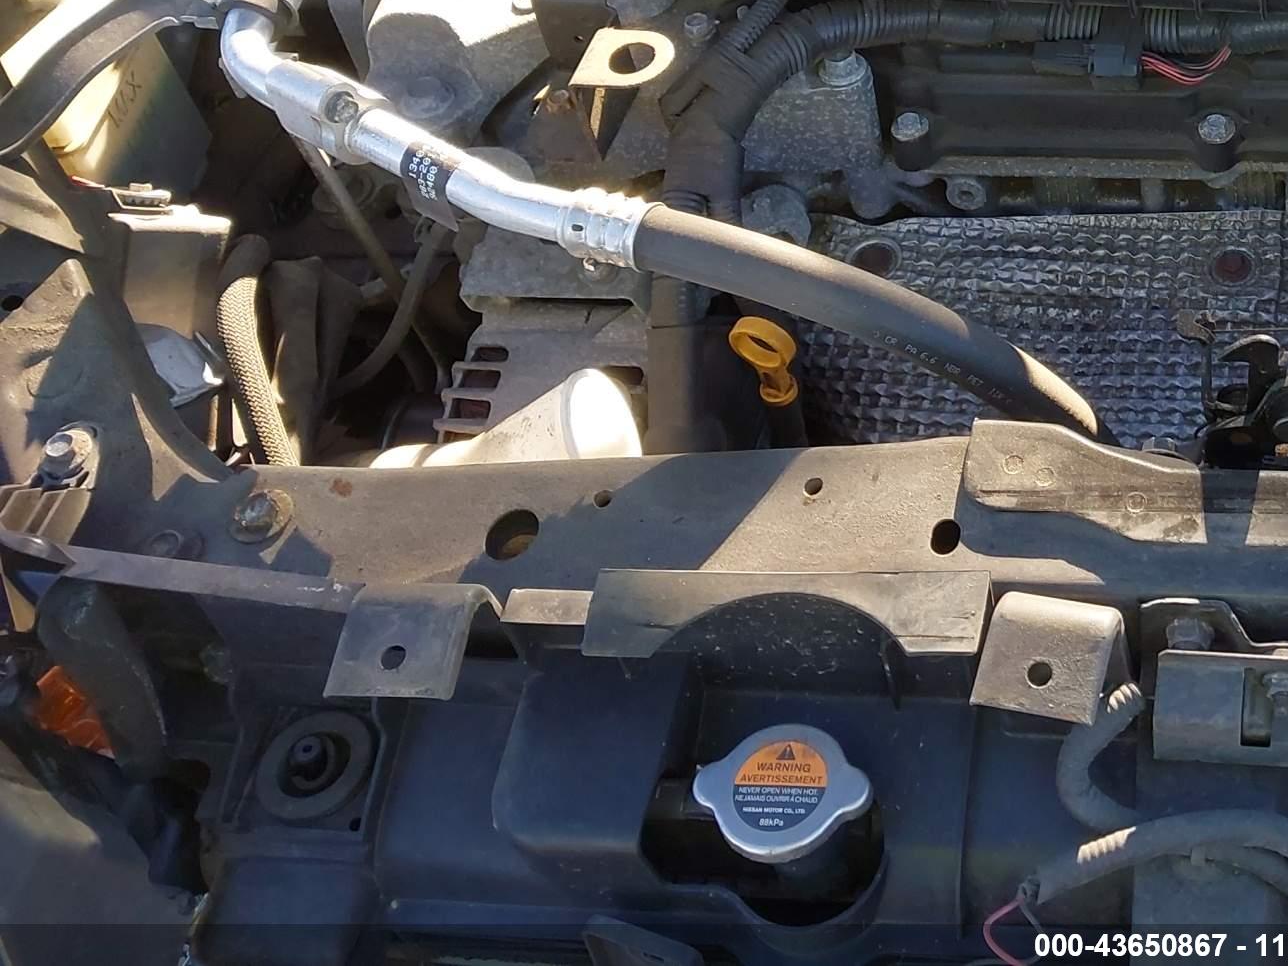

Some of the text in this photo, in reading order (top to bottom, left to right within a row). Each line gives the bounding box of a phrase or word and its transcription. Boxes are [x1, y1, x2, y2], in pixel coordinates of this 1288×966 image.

[757, 761, 812, 773] WARNING
[740, 773, 823, 784] AVERTISSEMENT
[759, 818, 784, 827] 88kPa
